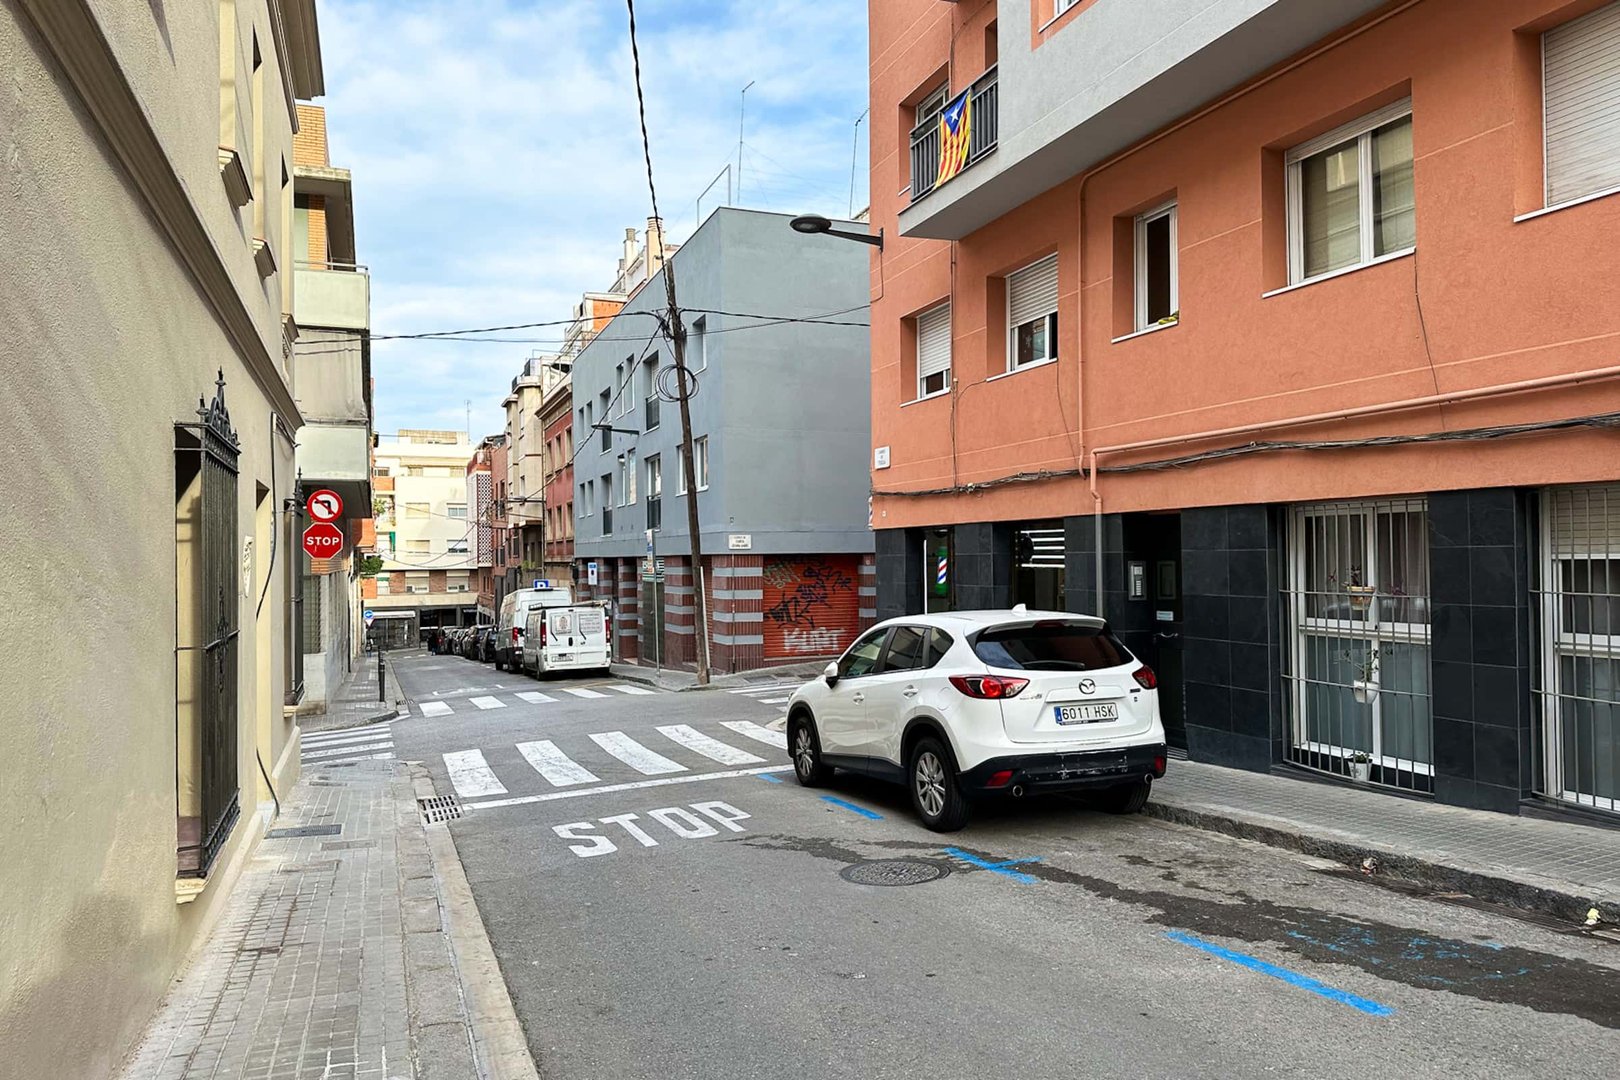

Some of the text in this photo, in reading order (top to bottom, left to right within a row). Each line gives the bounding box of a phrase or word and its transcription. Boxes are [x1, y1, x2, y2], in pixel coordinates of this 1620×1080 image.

[306, 536, 339, 546] STOP
[1062, 706, 1114, 720] 6011 HSK
[551, 800, 752, 858] STOP
